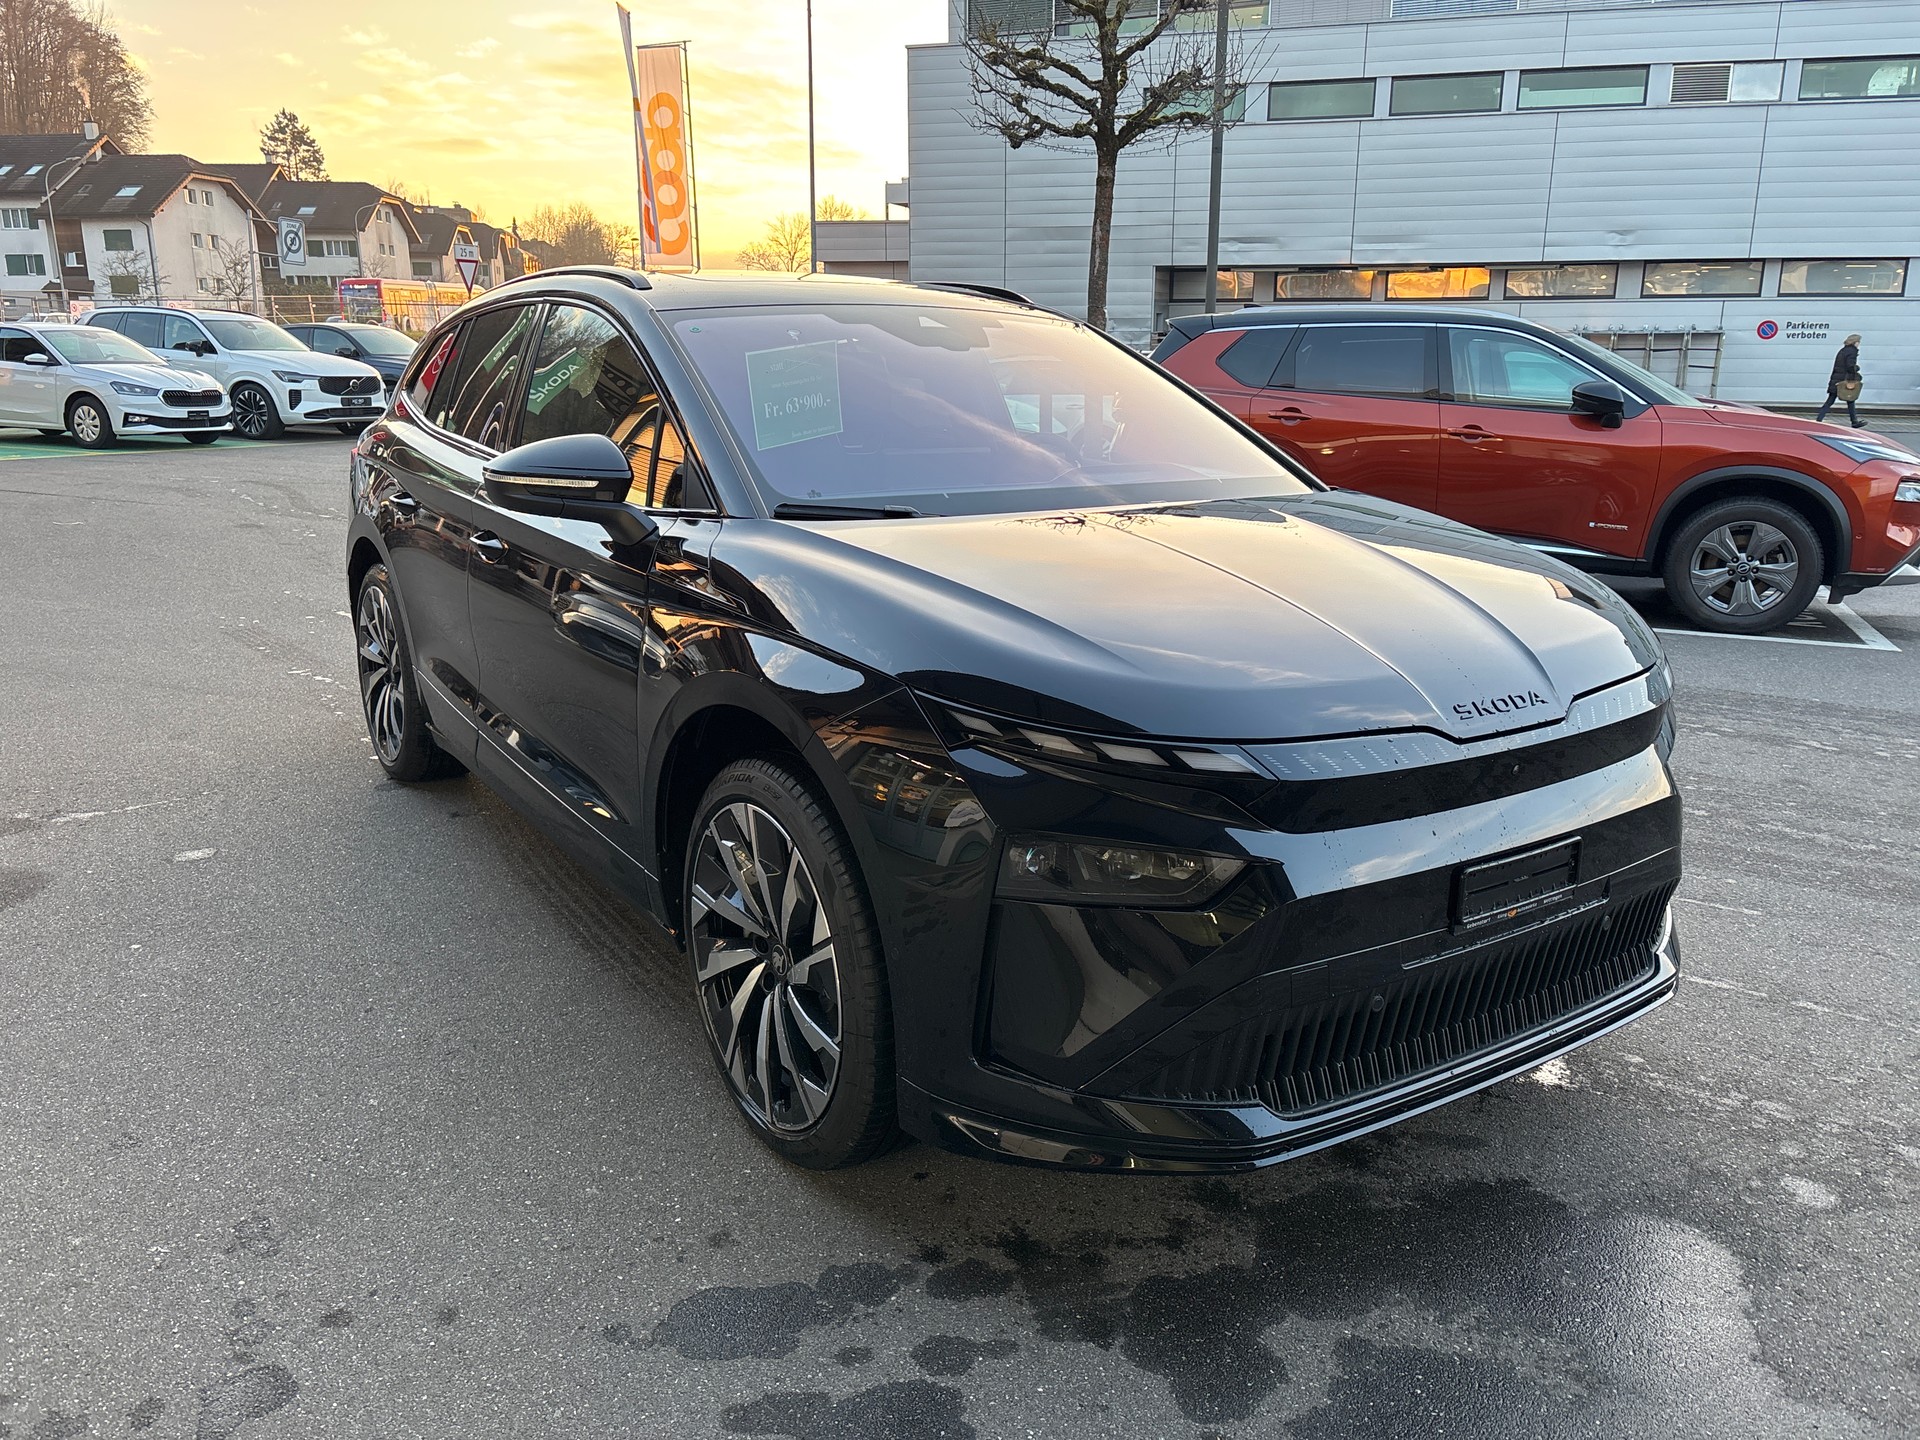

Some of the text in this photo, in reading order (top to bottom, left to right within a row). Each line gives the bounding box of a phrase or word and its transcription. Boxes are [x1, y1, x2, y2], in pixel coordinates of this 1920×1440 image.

[460, 247, 475, 258] 25 m
[1786, 321, 1830, 330] Parkieren
[1786, 331, 1827, 339] verboten
[764, 402, 783, 418] Fr.
